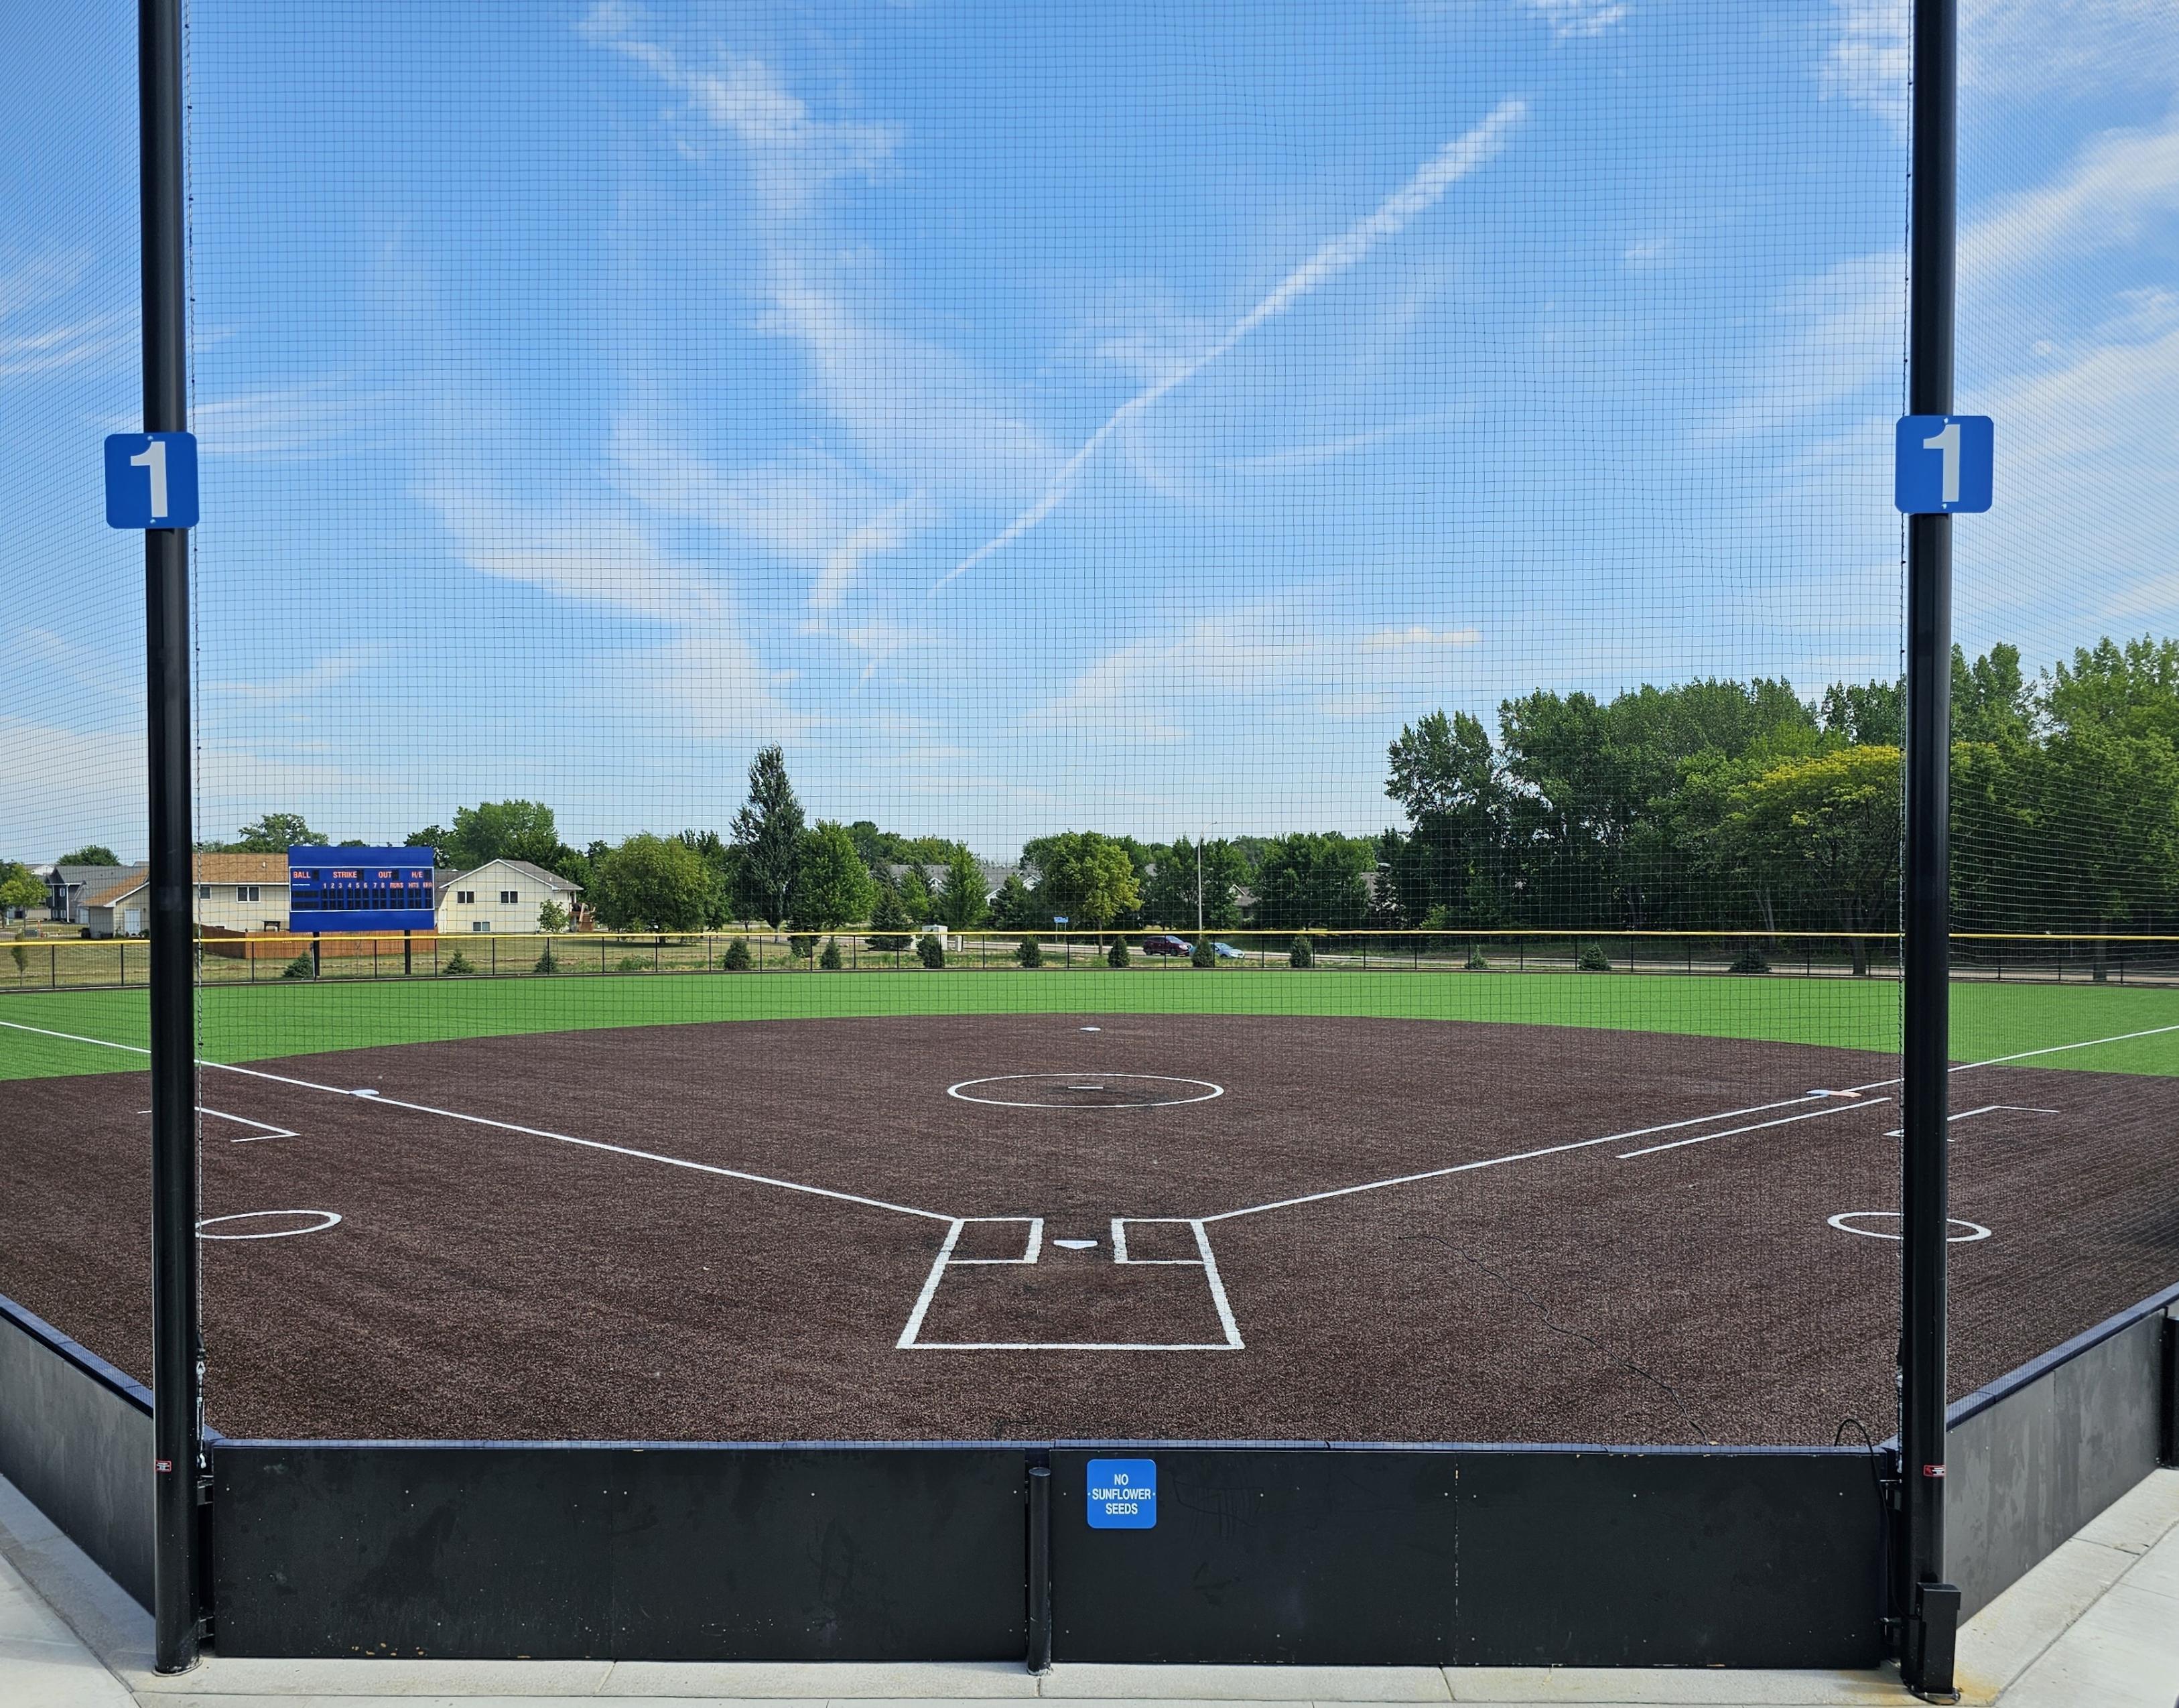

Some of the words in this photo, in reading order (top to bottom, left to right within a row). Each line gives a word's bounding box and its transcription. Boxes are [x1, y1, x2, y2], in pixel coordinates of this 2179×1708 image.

[1923, 424, 1961, 502] 1
[131, 441, 168, 517] 1
[1114, 1474, 1128, 1485] NO
[1092, 1488, 1151, 1500] SUNFLOWER
[1106, 1503, 1138, 1514] SEEDS
